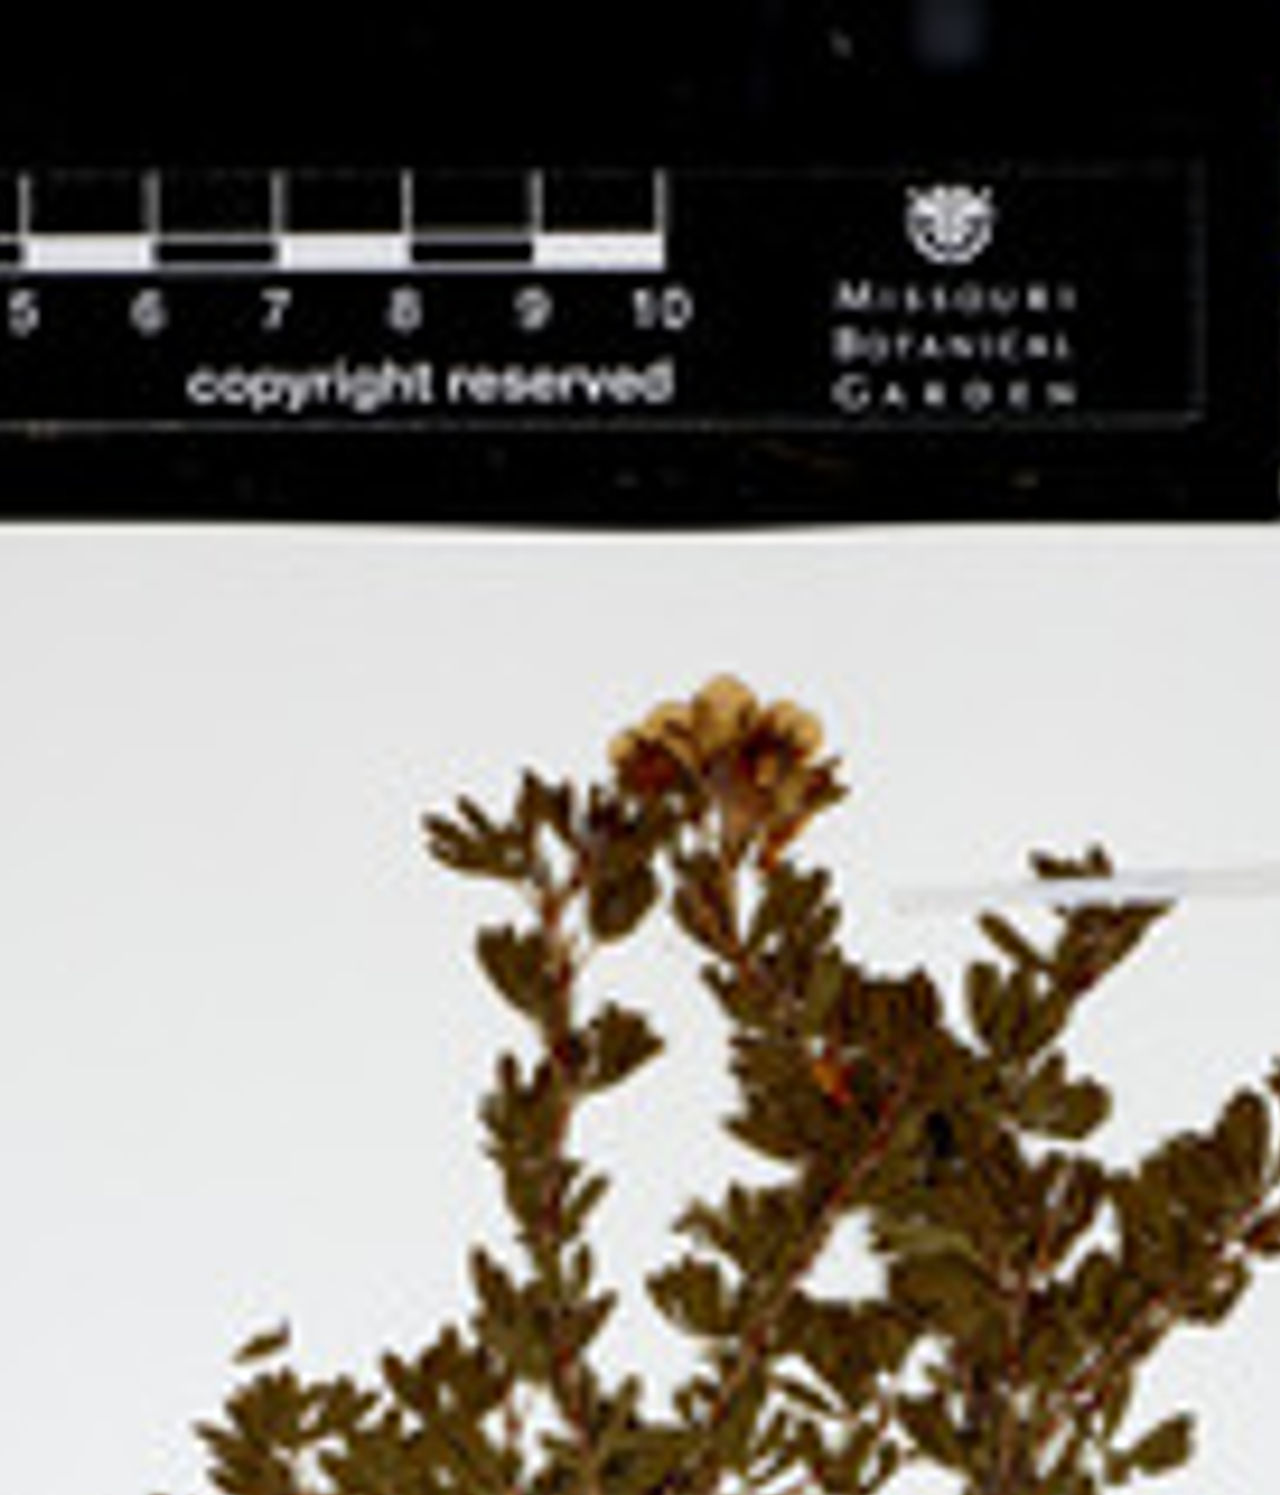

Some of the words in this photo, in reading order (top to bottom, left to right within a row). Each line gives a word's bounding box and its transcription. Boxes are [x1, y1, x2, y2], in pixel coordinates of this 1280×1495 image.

[7, 289, 39, 337] 5
[130, 289, 165, 334] 6
[261, 289, 292, 330] 7
[389, 288, 421, 334] 8
[515, 288, 551, 331] 9
[632, 289, 693, 331] 10
[185, 354, 433, 412] copyright
[448, 357, 675, 403] reserved
